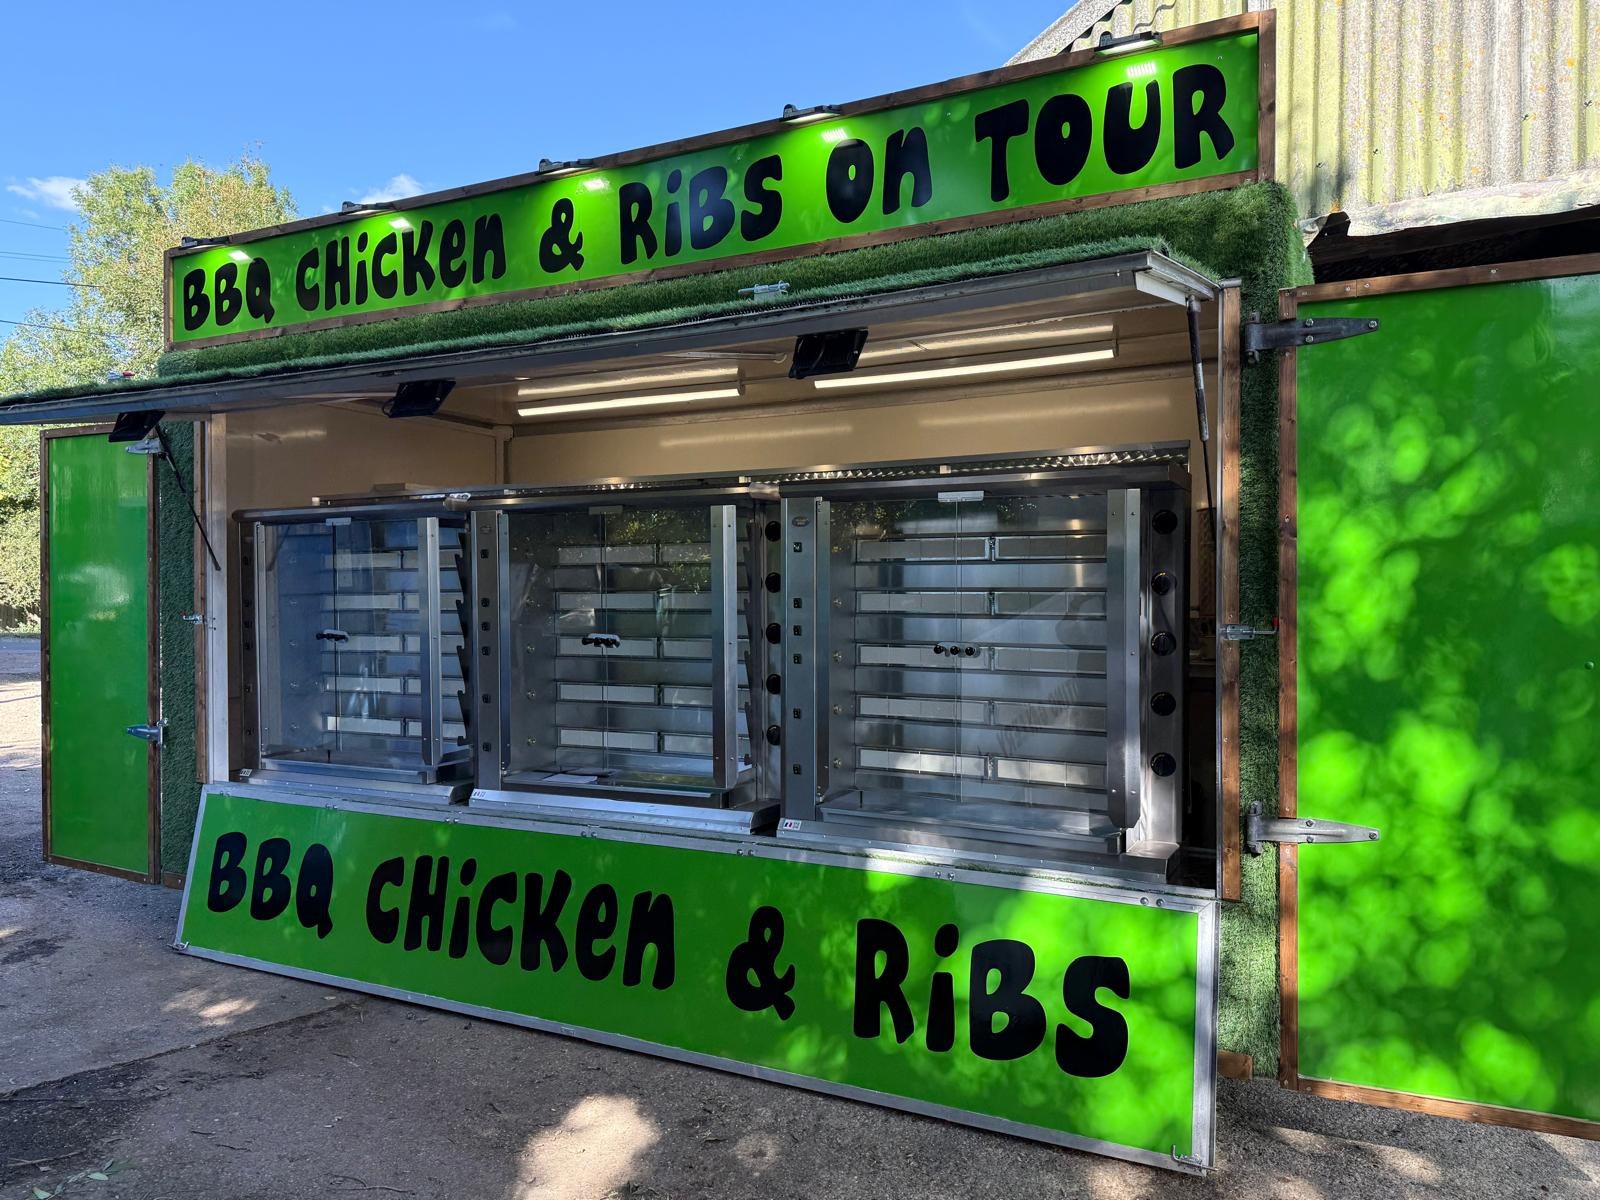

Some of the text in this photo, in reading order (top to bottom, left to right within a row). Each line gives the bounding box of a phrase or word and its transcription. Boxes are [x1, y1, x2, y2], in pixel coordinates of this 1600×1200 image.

[183, 257, 275, 331] BBQ
[538, 198, 585, 274] &
[974, 63, 1235, 203] TOUR
[207, 831, 334, 940] BBQ
[725, 905, 796, 1022] &
